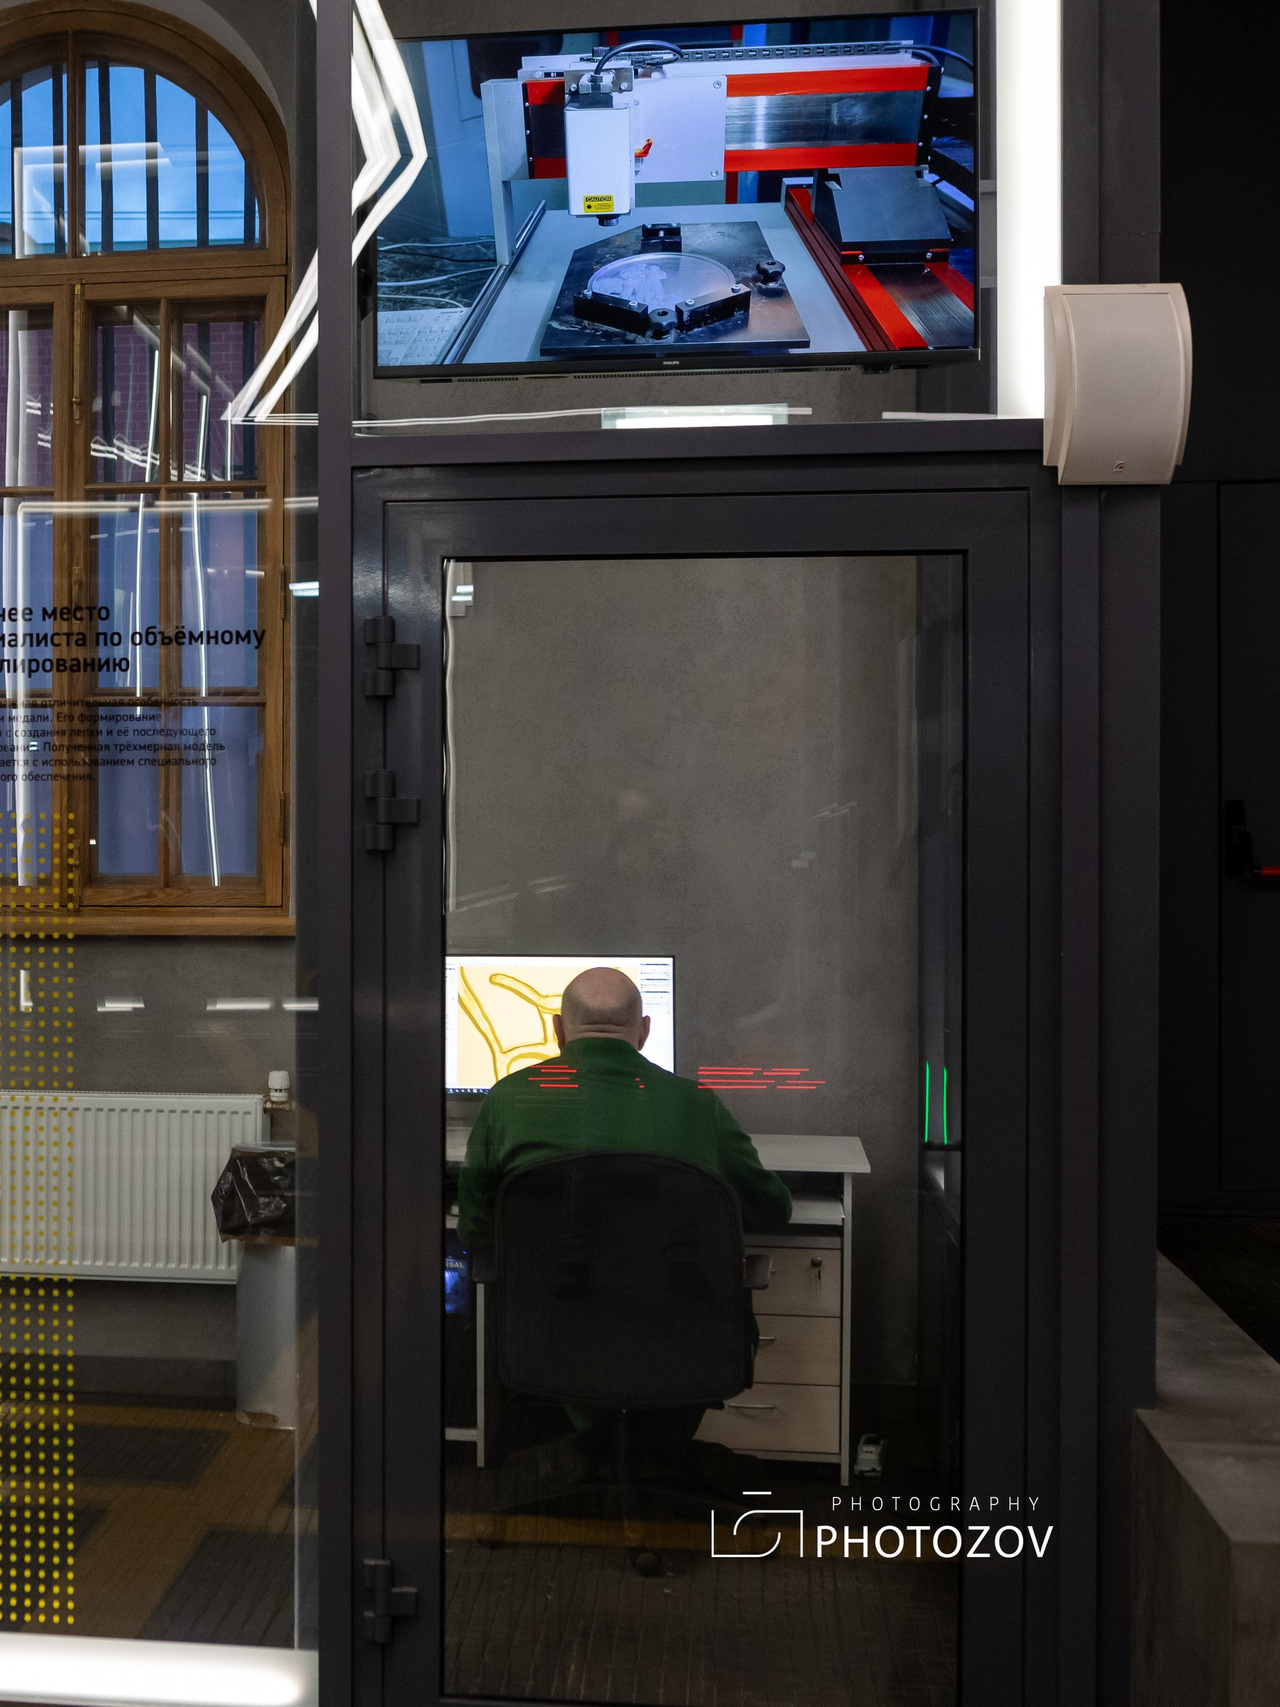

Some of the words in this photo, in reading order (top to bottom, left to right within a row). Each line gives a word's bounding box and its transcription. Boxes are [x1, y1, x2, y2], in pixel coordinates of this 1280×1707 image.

[42, 605, 110, 622] место
[96, 631, 122, 646] по
[131, 625, 266, 649] объёмному
[40, 698, 125, 708] отличительная
[127, 696, 198, 707] особенность
[8, 714, 53, 724] медали.
[56, 713, 74, 722] Его
[78, 713, 162, 725] формирование
[5, 729, 12, 737] с
[15, 728, 67, 739] создания
[69, 728, 102, 737] лепки
[106, 728, 113, 737] и
[117, 726, 129, 737] её
[43, 742, 110, 754] Полученная
[114, 742, 181, 754] трёхмерная
[184, 743, 226, 753] модель
[32, 759, 39, 767] с
[42, 758, 135, 768] использованием
[22, 771, 96, 783] обеспечения.
